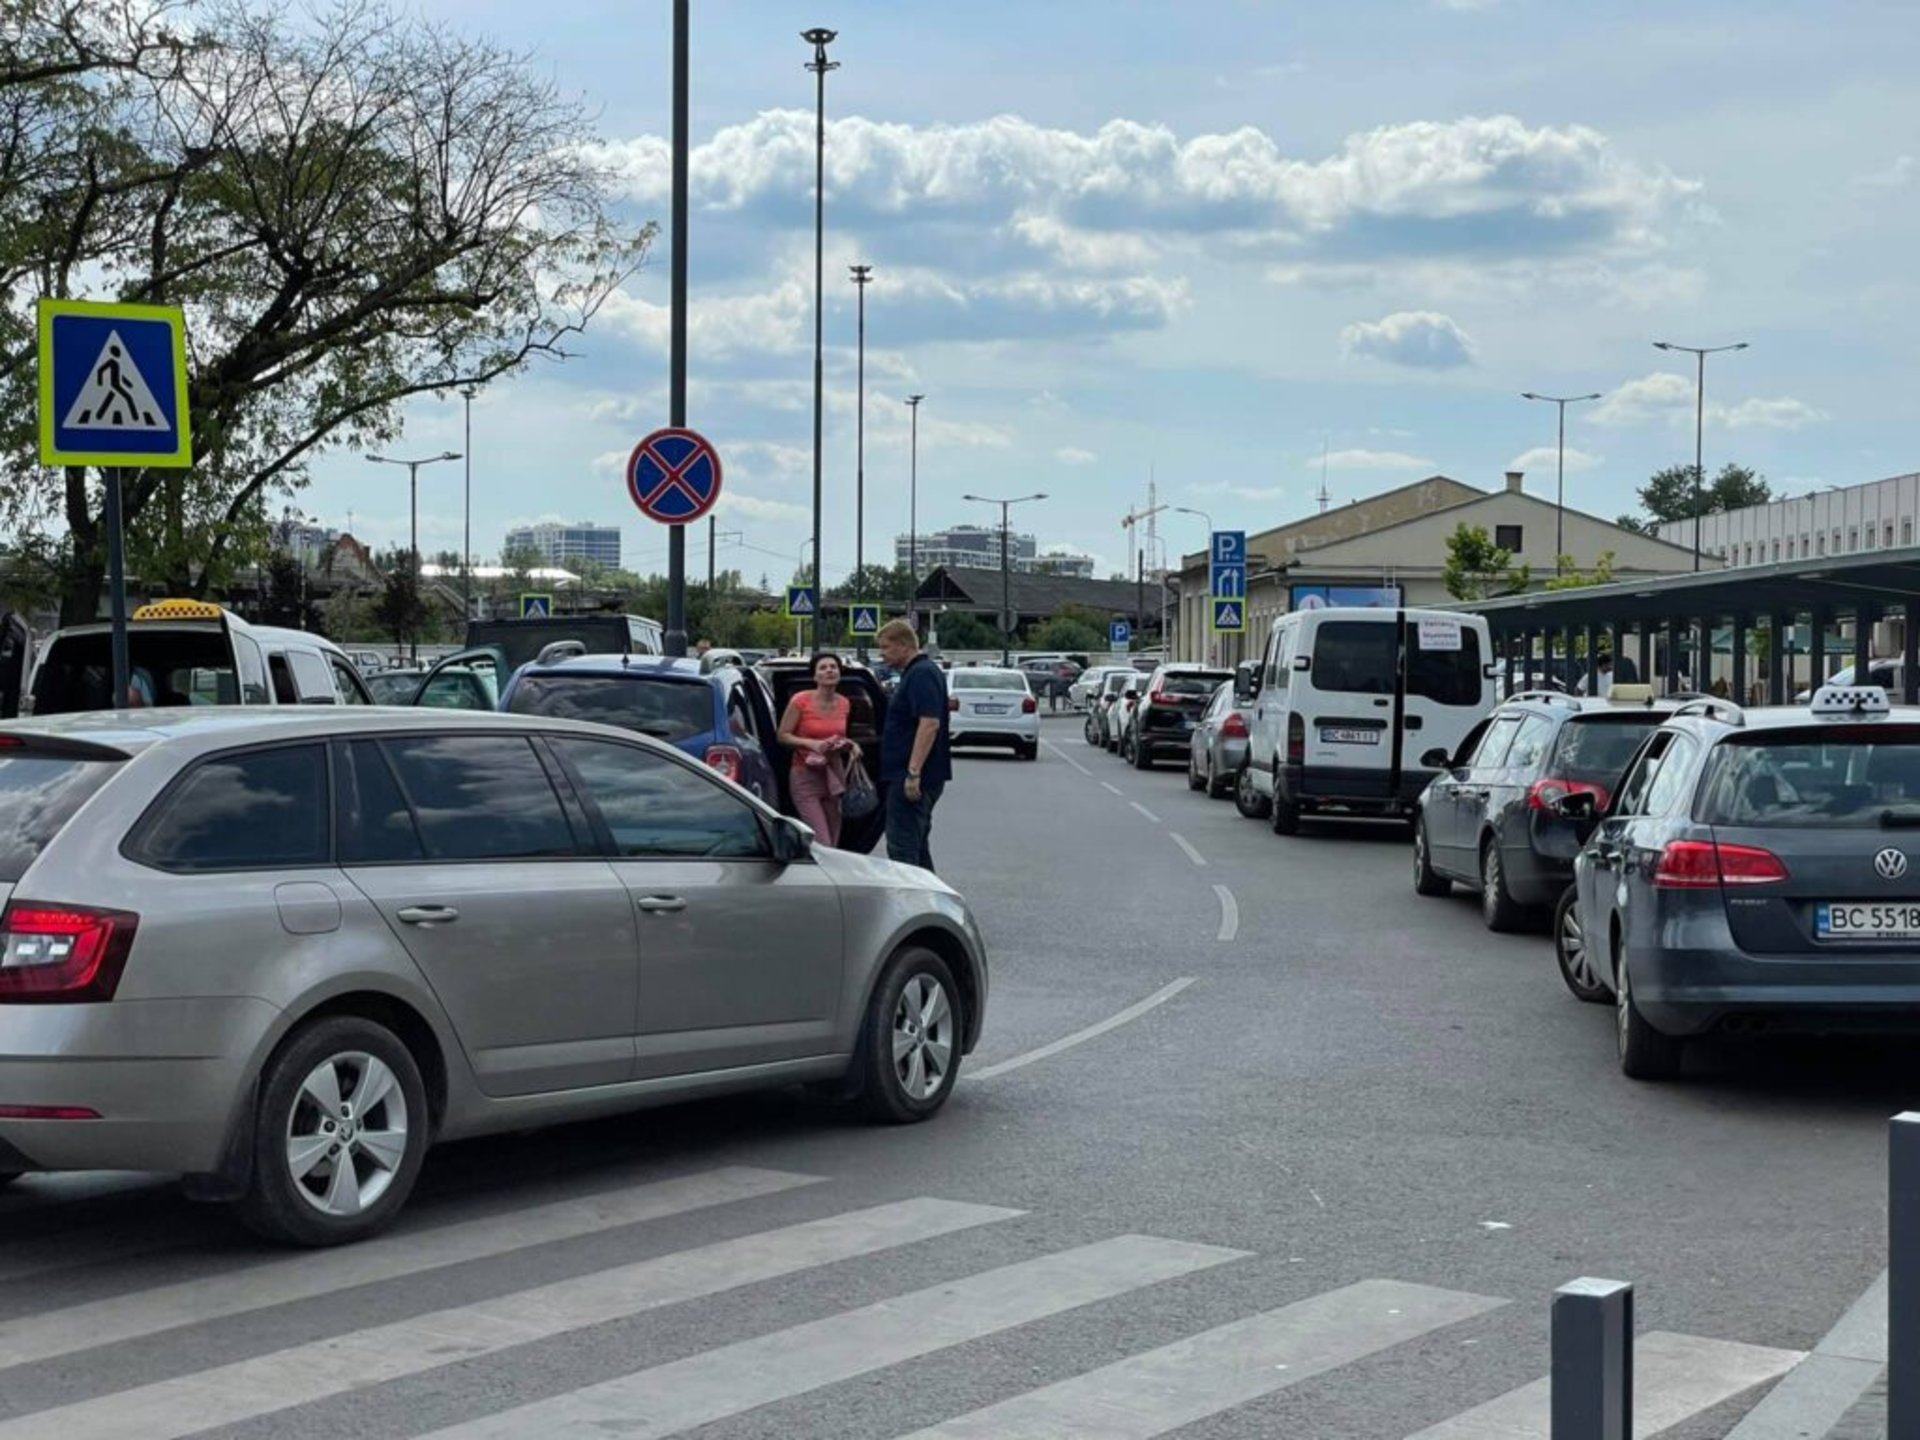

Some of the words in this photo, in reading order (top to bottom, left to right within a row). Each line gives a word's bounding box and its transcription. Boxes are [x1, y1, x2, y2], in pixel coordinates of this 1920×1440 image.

[1218, 535, 1237, 561] P
[1115, 625, 1126, 640] P
[1831, 907, 1865, 929] BC
[1871, 907, 1920, 929] 5518
